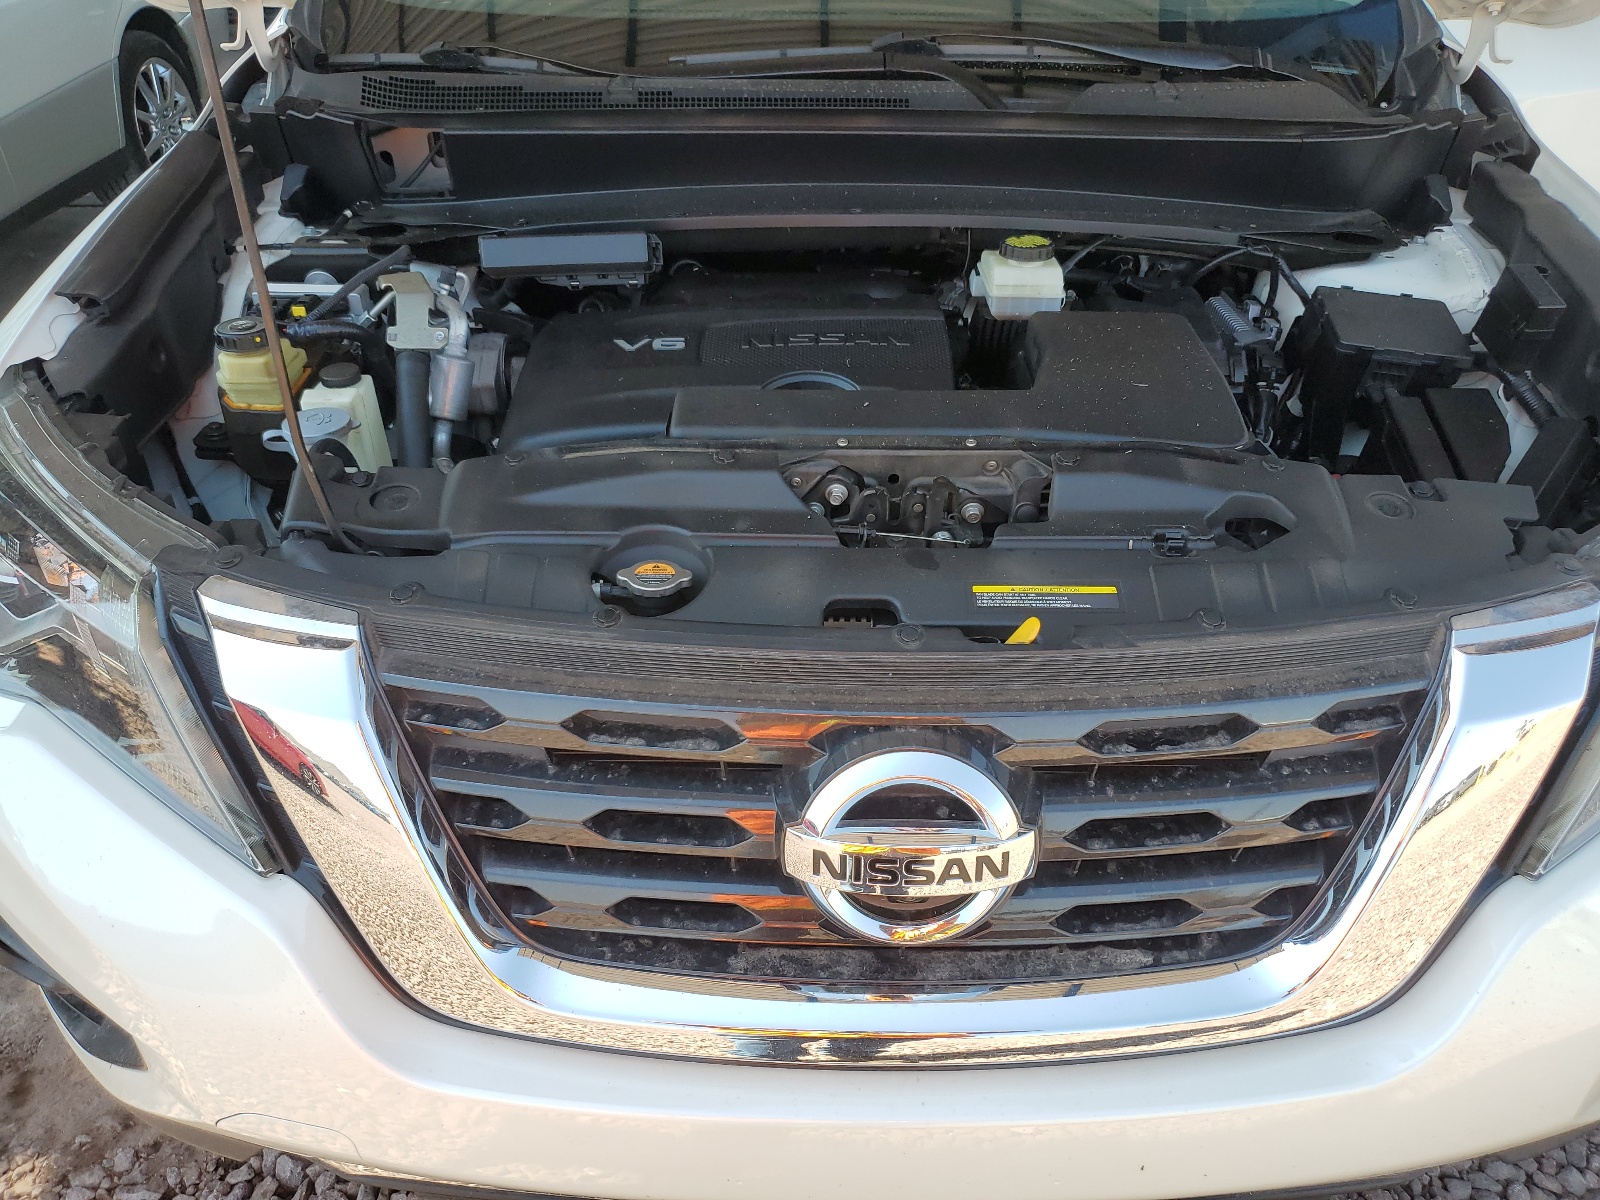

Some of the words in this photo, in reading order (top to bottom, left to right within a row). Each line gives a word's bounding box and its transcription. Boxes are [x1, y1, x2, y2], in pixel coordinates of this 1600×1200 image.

[613, 337, 686, 352] V6
[741, 334, 911, 349] NISSAN
[812, 848, 1010, 887] NISSAN
